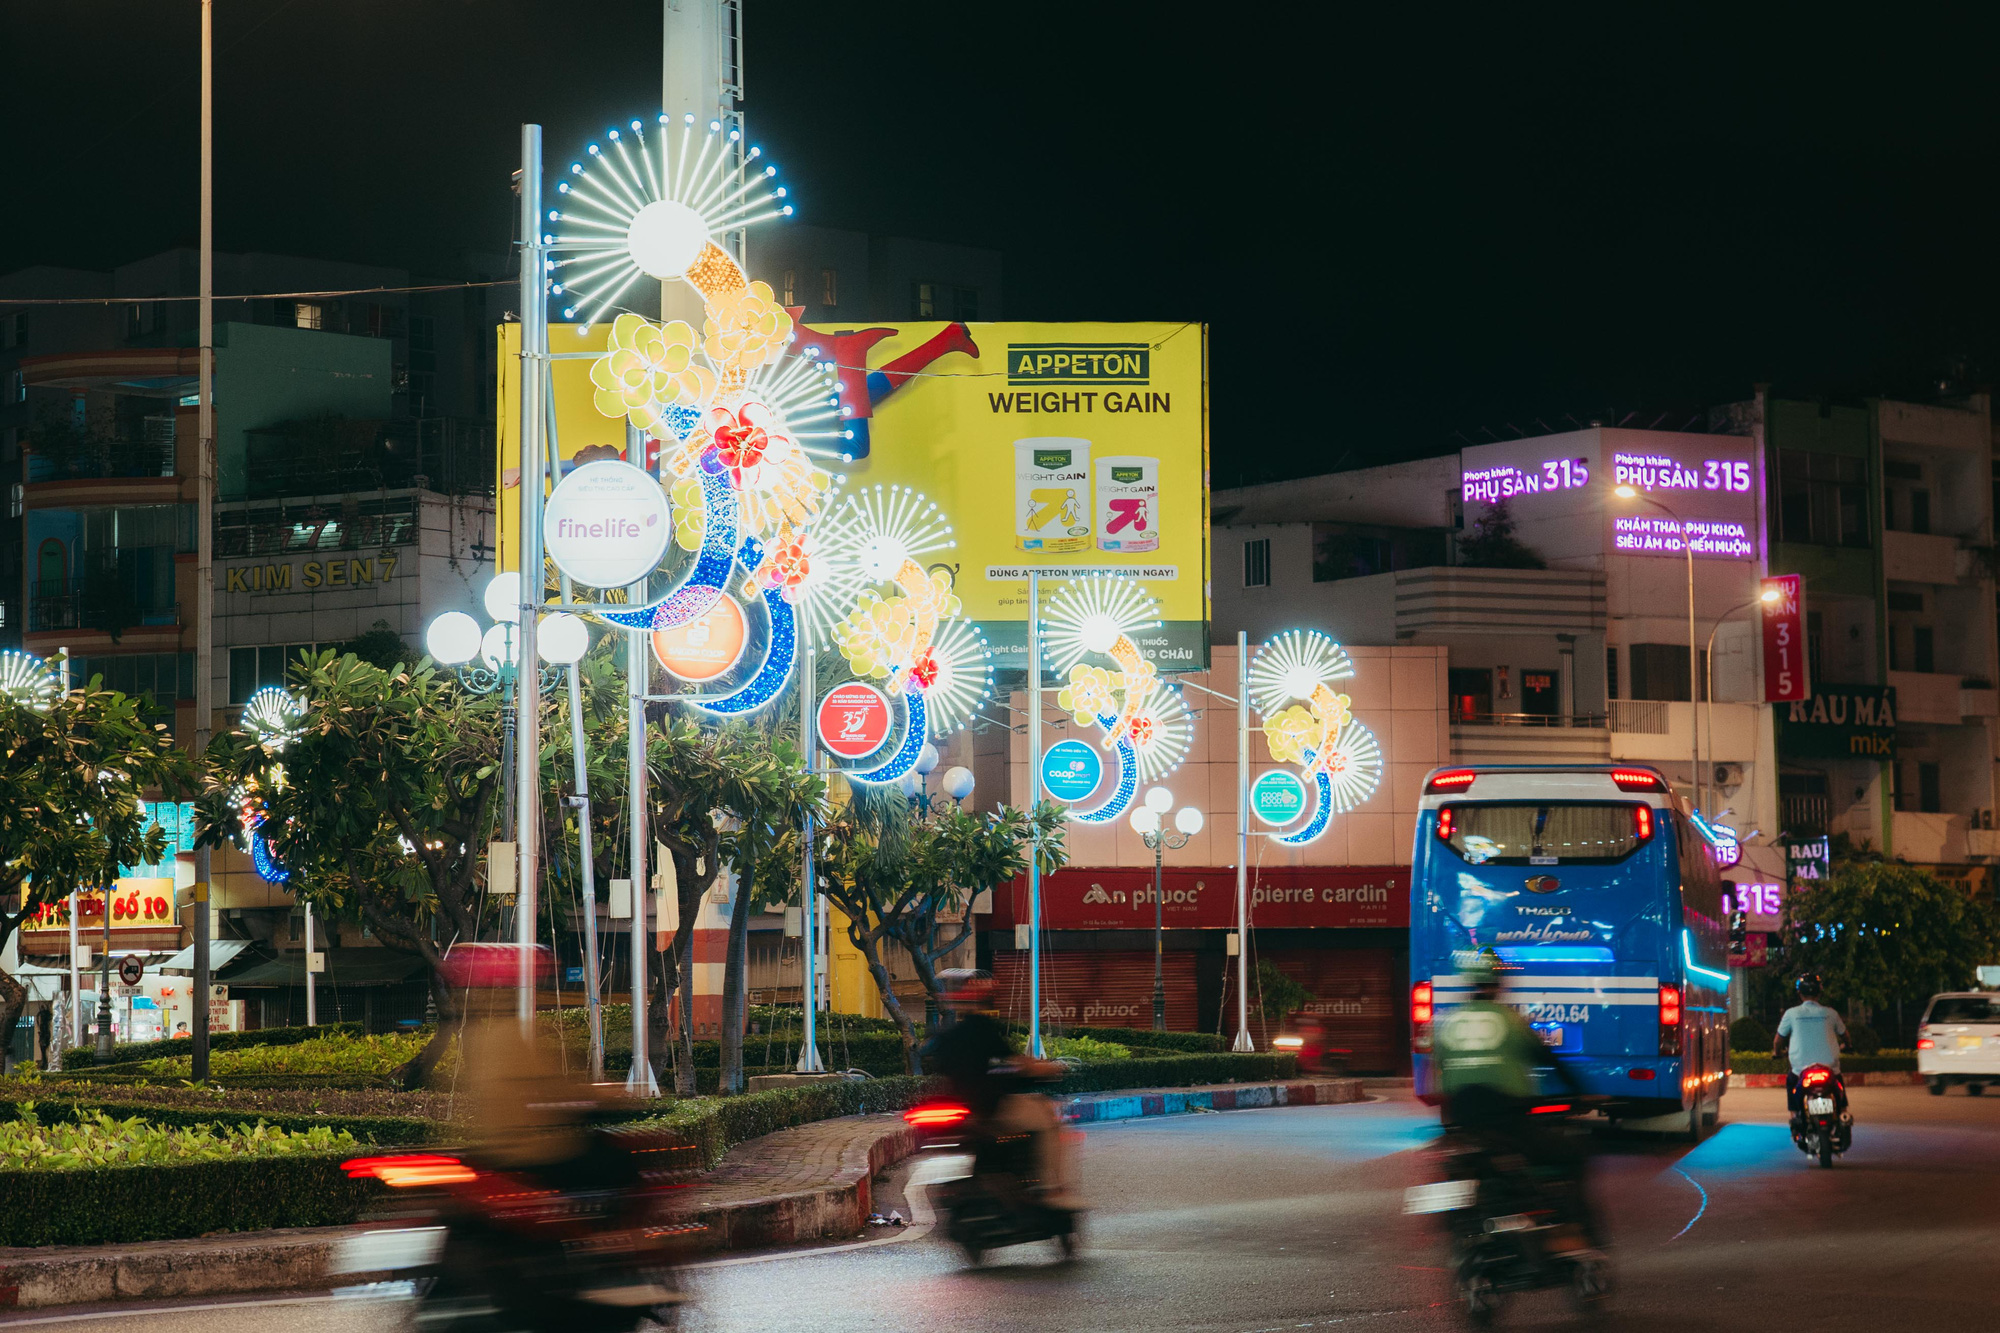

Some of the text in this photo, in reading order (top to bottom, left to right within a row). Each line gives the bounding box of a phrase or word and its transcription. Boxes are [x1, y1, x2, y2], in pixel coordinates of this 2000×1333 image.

[1017, 354, 1142, 375] APPETON
[988, 392, 1171, 413] WEIGHT GAIN
[1056, 472, 1086, 481] GAIN
[1463, 457, 1589, 503] PHỤ SẢN 315
[1615, 460, 1750, 492] PHỤ SẢN 315
[1130, 485, 1155, 493] GAIN
[558, 518, 641, 538] finelife
[1616, 516, 1651, 532] KHÁM
[1711, 524, 1745, 538] KHOA
[1616, 533, 1642, 548] SIÊU
[1643, 535, 1662, 549] ÂM
[1715, 539, 1751, 556] MUỘN
[226, 564, 292, 593] KIM
[989, 566, 1019, 577] DÙNG
[1143, 569, 1174, 577] NGAY!
[978, 644, 1012, 655] Weight
[1141, 636, 1169, 646] THUỐC
[1159, 647, 1193, 660] CHÂU
[1789, 689, 1896, 726] RAU MÁ
[1850, 732, 1891, 754] mix
[1790, 844, 1822, 859] RAU
[1796, 861, 1819, 880] MÁ
[114, 889, 140, 916] SỐ
[144, 896, 166, 915] 10
[1133, 883, 1198, 911] phuoc
[1253, 884, 1387, 908] pierre cardin
[1735, 883, 1781, 915] 315
[1515, 906, 1571, 916] THACO
[1496, 923, 1592, 942] mobihome
[1083, 999, 1139, 1023] phuoc
[1303, 1000, 1362, 1014] cardin
